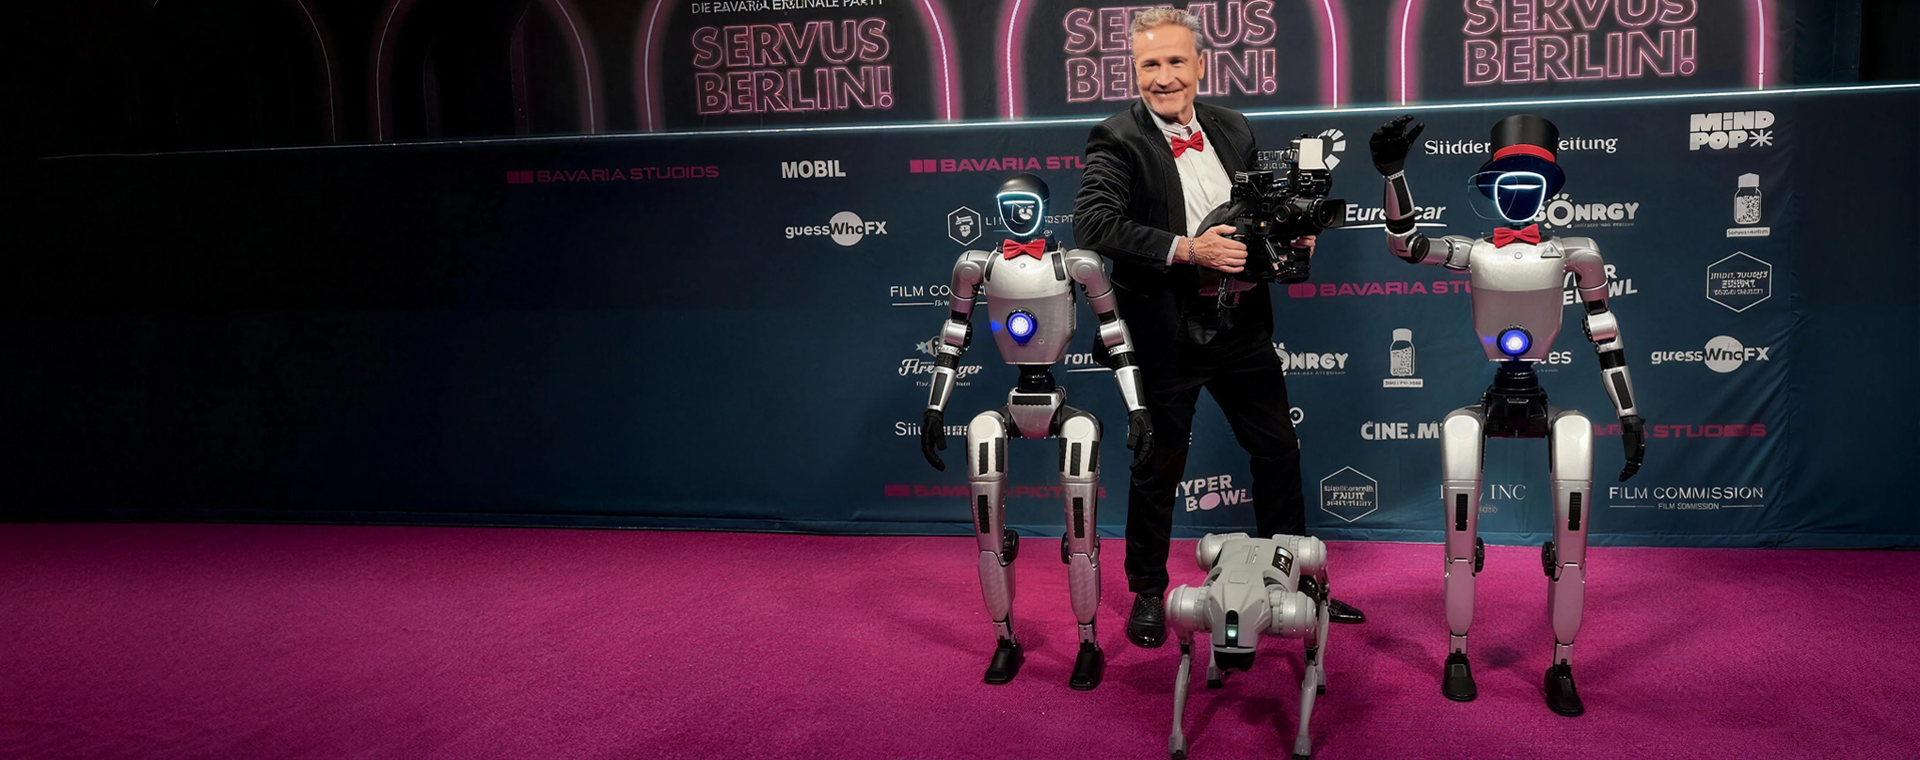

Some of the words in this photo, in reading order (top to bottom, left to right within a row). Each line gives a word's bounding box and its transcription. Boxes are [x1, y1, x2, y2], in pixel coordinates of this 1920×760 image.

[691, 3, 711, 14] DIE
[1463, 0, 1699, 35] SERVUS
[1063, 0, 1278, 53] SEUS
[692, 18, 890, 69] SERVUS
[1464, 28, 1696, 85] BERLIN!
[1066, 49, 1278, 102] BEIN!
[695, 66, 893, 115] BERLIN!
[1557, 136, 1619, 154] eitung
[781, 160, 847, 179] MOBIL
[940, 157, 1042, 173] BAVARIA
[537, 168, 627, 183] BAVARIA
[890, 286, 924, 298] FILM
[1320, 281, 1427, 297] BAVARIA
[1360, 420, 1443, 441] CINE.M
[1490, 483, 1527, 501] INC
[1609, 486, 1648, 500] FILM
[1653, 486, 1764, 500] COMMISSION
